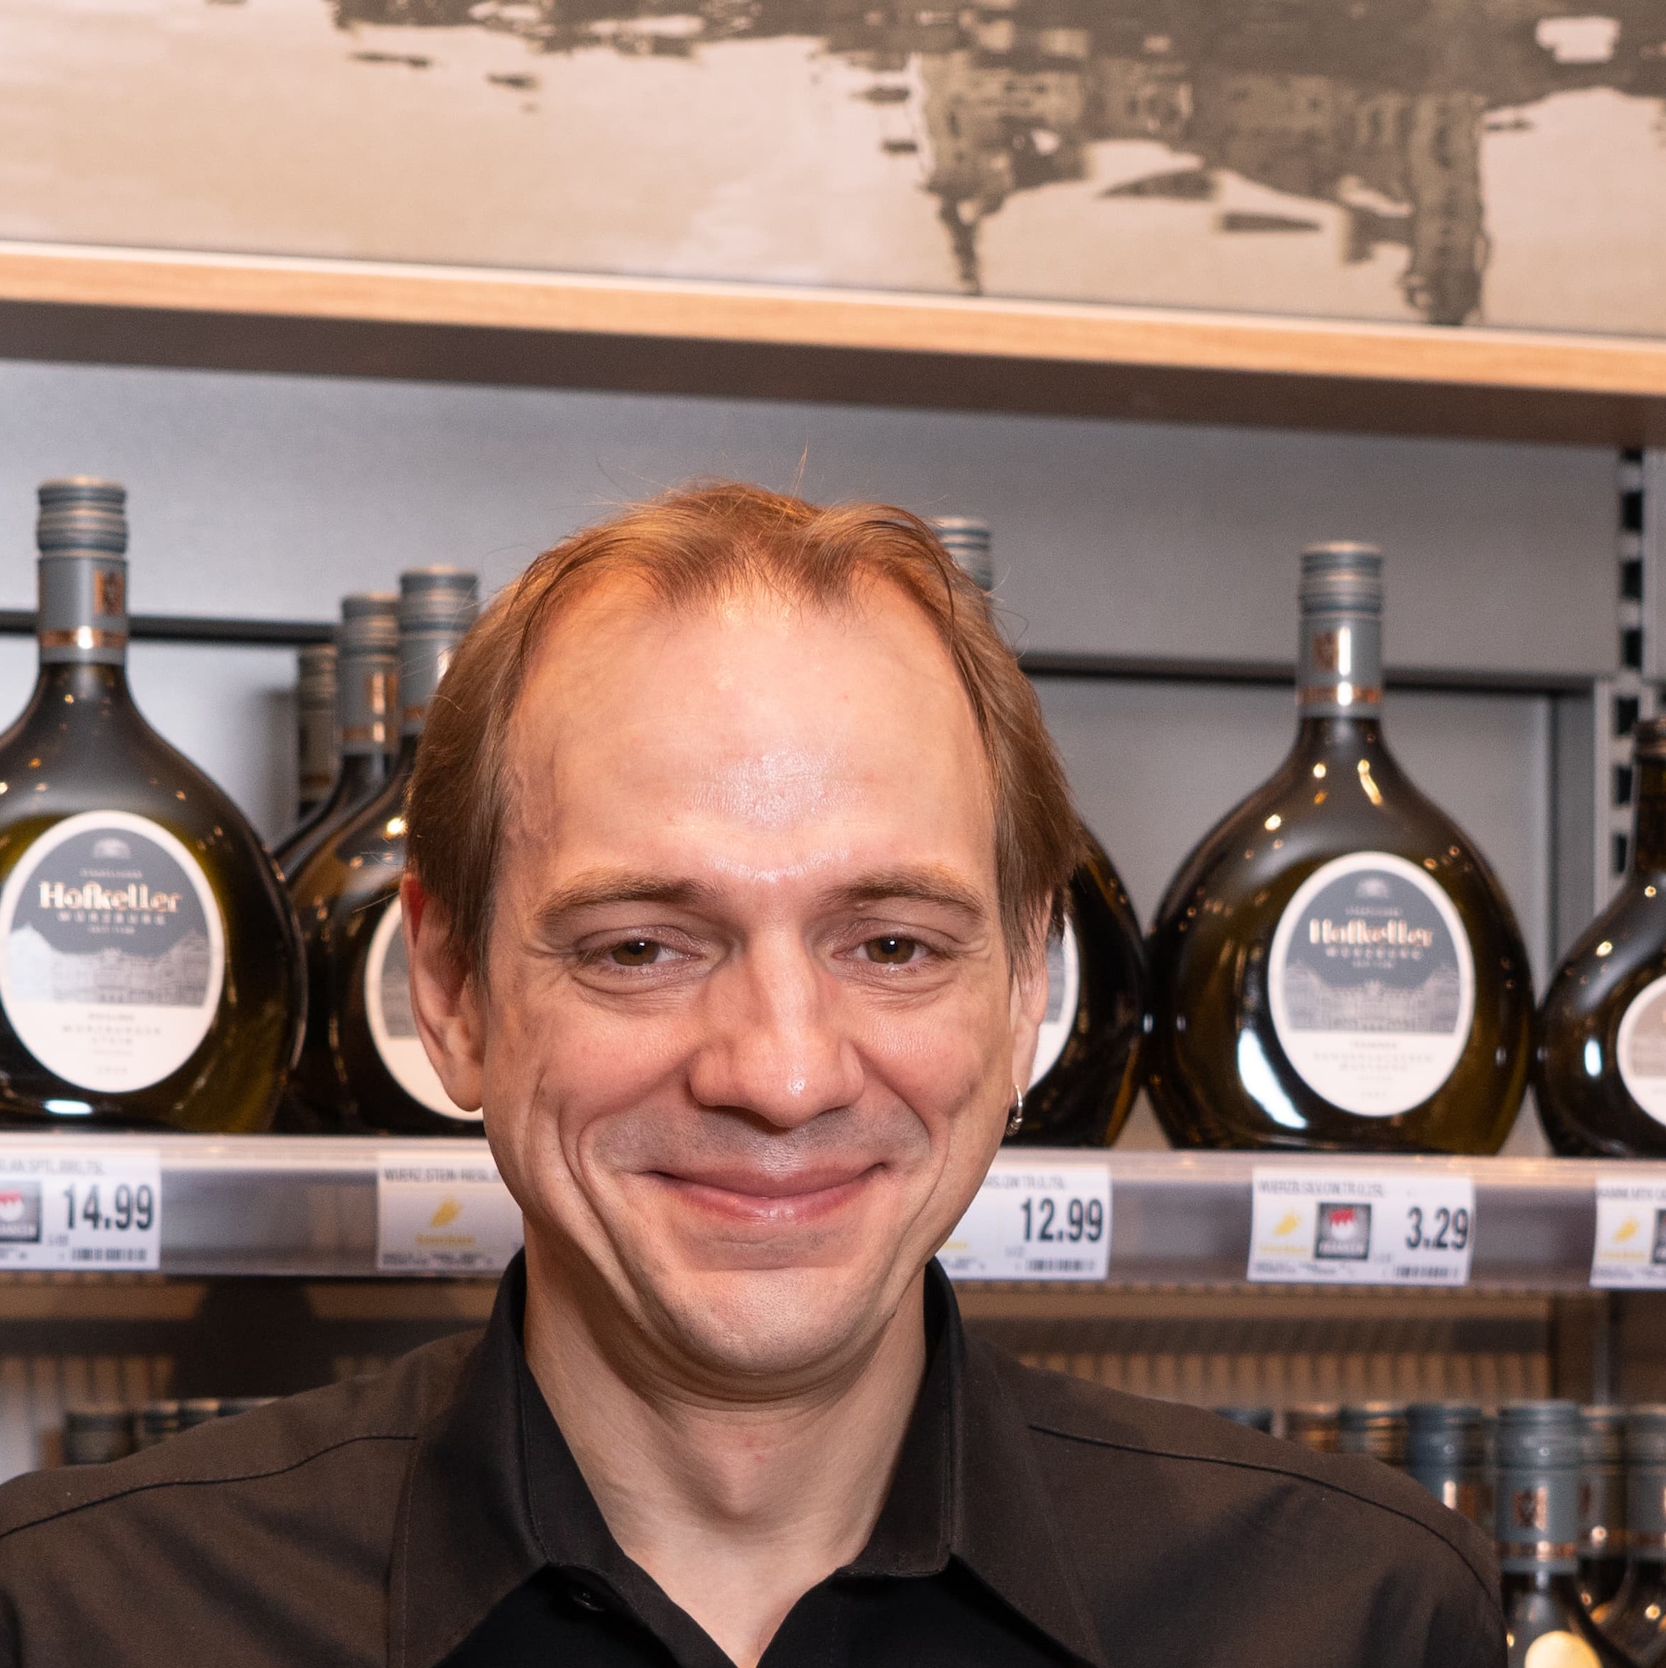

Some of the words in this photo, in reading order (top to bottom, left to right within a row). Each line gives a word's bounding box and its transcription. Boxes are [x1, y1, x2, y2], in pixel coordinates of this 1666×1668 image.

[38, 881, 181, 913] Hofkeller
[64, 1182, 154, 1230] 14.99
[1021, 1197, 1104, 1242] 12.99
[1406, 1206, 1469, 1250] 3.29
